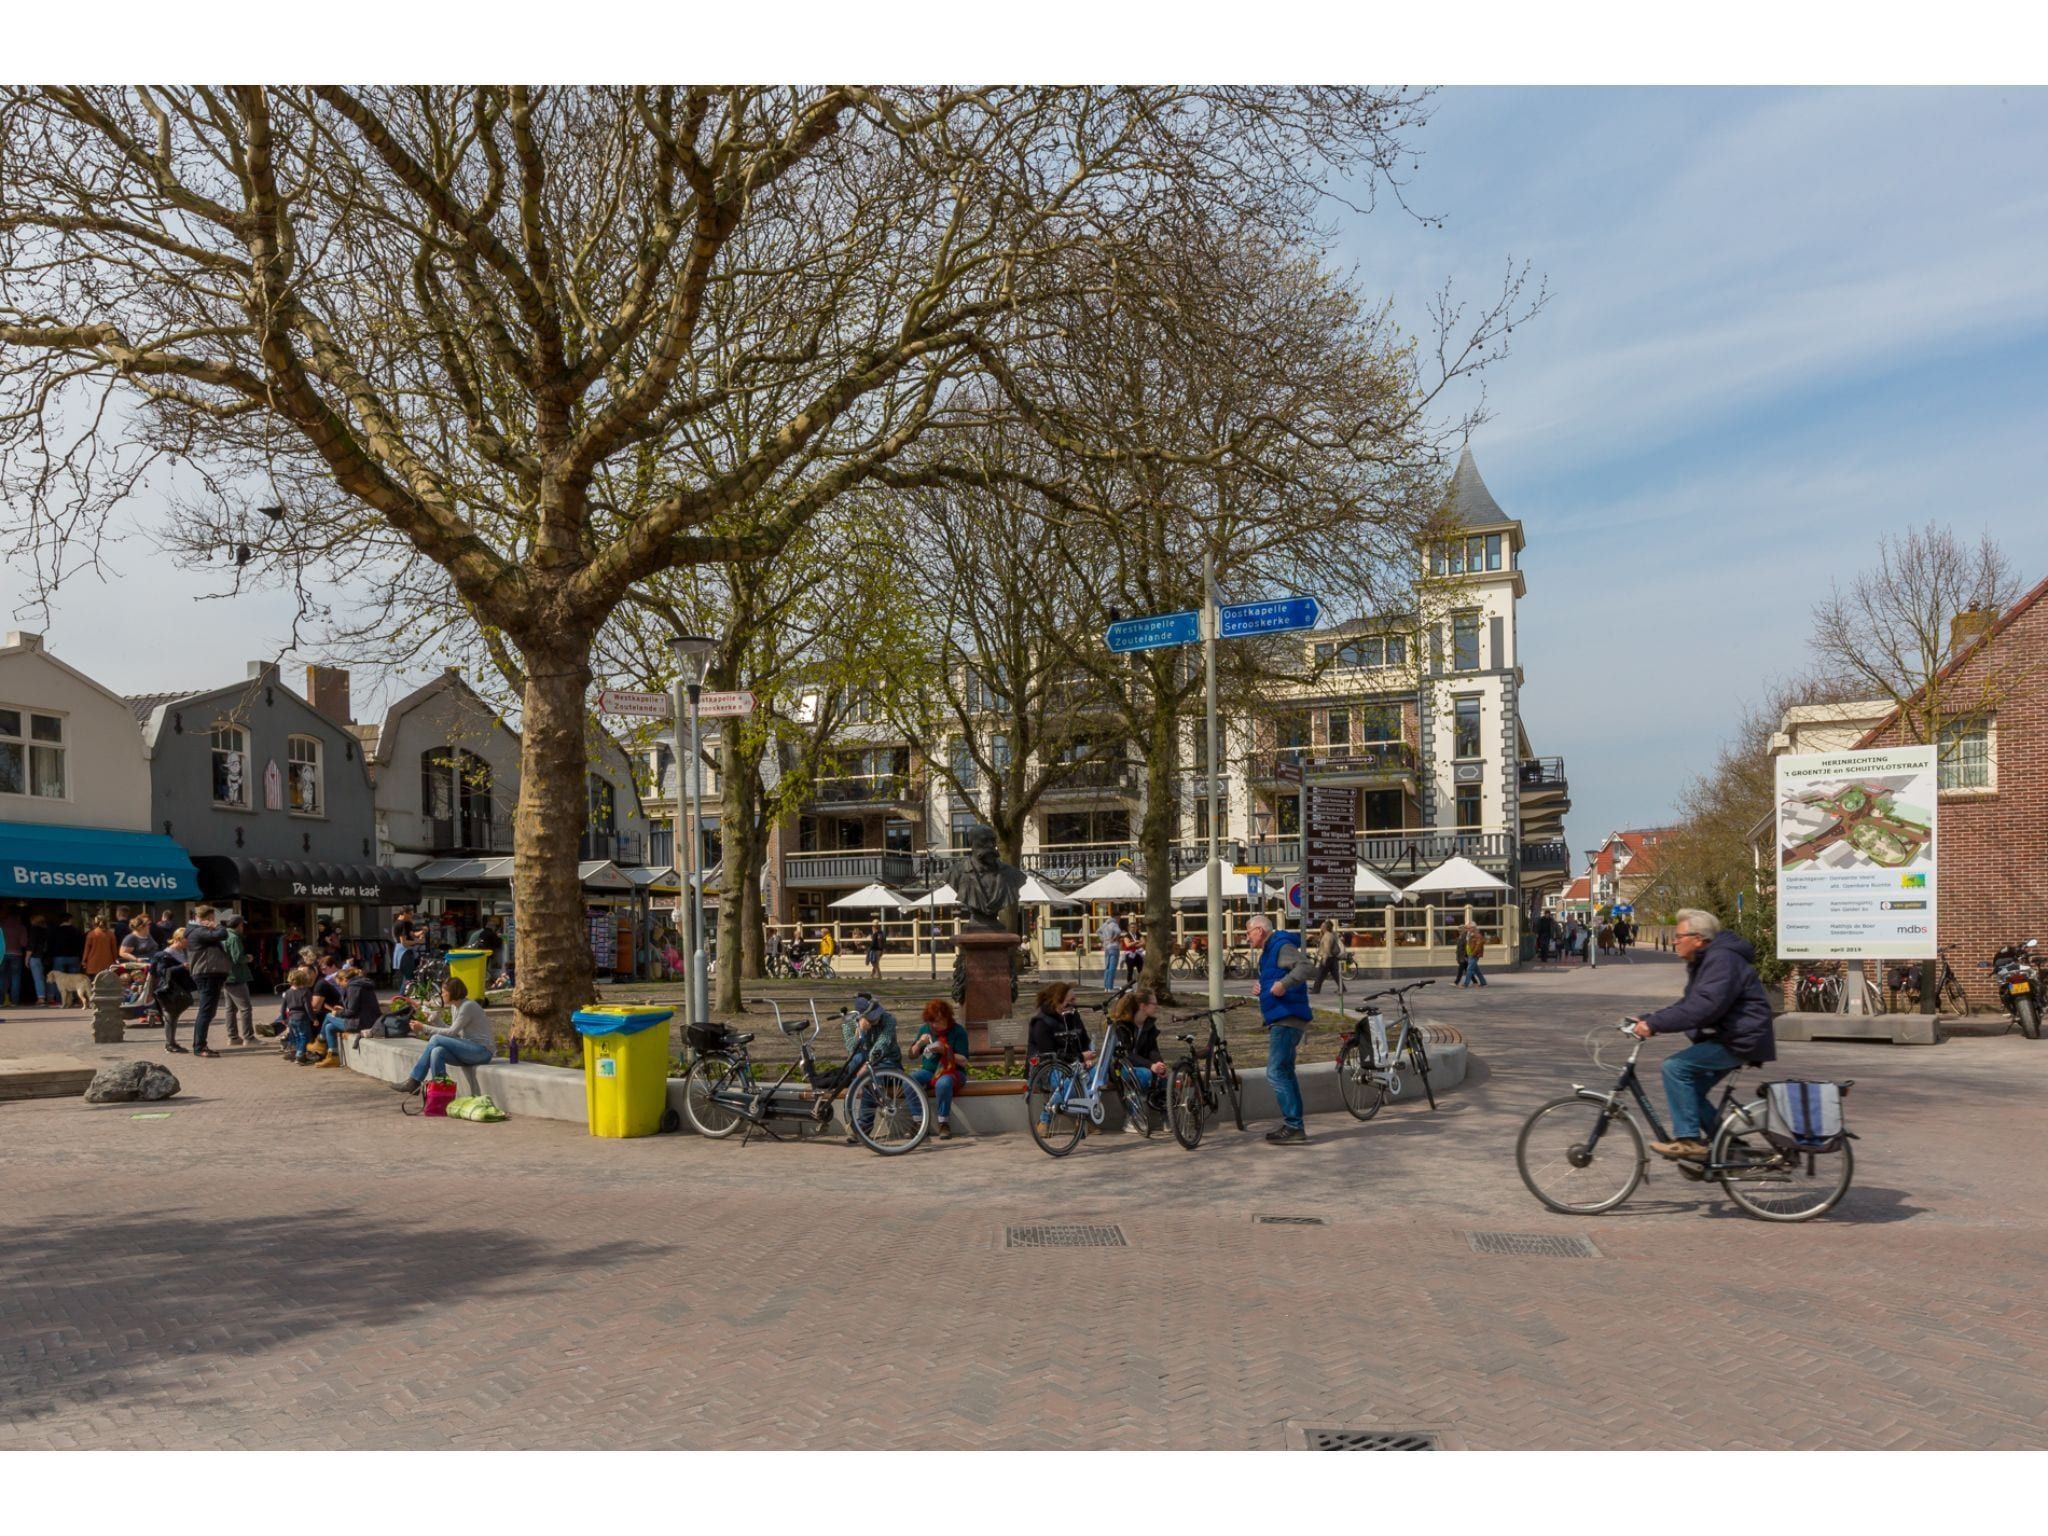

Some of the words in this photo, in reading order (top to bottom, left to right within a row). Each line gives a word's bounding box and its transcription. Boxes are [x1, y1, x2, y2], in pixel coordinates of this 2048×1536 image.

[1224, 604, 1288, 619] Oostkapelle
[1304, 602, 1311, 610] 4
[1114, 619, 1175, 635] Westkapelle
[1224, 616, 1290, 631] Serooskerke
[1114, 632, 1173, 646] Zoutelande
[1187, 629, 1196, 637] 13
[614, 694, 658, 703] Westkapelle
[700, 695, 736, 704] stkapelle
[614, 703, 657, 712] Zoutelande
[698, 704, 737, 712] rooskerke
[1791, 768, 1832, 776] GROENTJE
[1845, 761, 1929, 773] SCHUITVLOTSTRAAT
[1821, 756, 1888, 767] HERINRICHTING
[13, 866, 108, 887] Brassem
[114, 871, 178, 889] Zeevis
[292, 882, 307, 895] De
[311, 883, 335, 896] keet
[339, 886, 356, 896] van
[359, 884, 381, 897] kaat
[1897, 925, 1928, 934] mdbs
